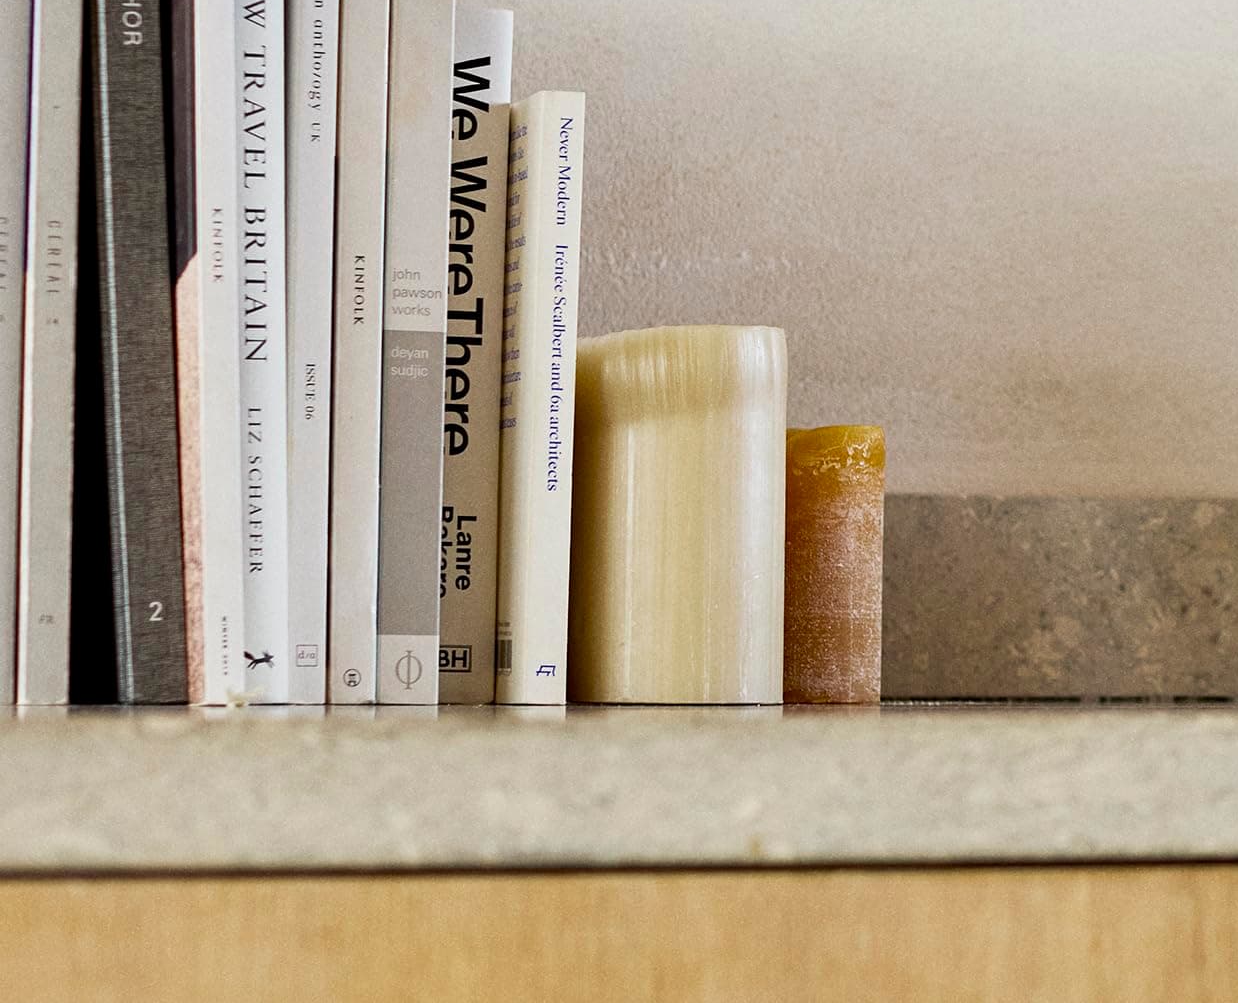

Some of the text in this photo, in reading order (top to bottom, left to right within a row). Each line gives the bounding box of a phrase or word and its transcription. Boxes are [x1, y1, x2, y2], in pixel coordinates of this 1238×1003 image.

[307, 19, 326, 111] anthology
[243, 45, 266, 189] TRAVEL
[559, 117, 573, 162] Never
[556, 166, 572, 225] Modern
[212, 208, 224, 284] KINFOLK
[443, 56, 491, 456] We Were There
[554, 245, 569, 293] Irénée
[244, 207, 267, 361] BRITAIN
[353, 255, 366, 326] KINFOLK
[392, 267, 421, 282] john
[392, 288, 442, 299] pawson
[392, 305, 431, 316] works
[551, 295, 566, 358] Scalbert
[391, 346, 429, 360] deyan
[391, 364, 428, 378] sudjic
[550, 363, 564, 391] and
[305, 364, 315, 401] ISSUE
[248, 408, 262, 444] LIZ
[547, 416, 562, 492] architects
[248, 455, 264, 574] SCHAFFER
[455, 515, 477, 591] Lanre
[148, 601, 163, 621] 2
